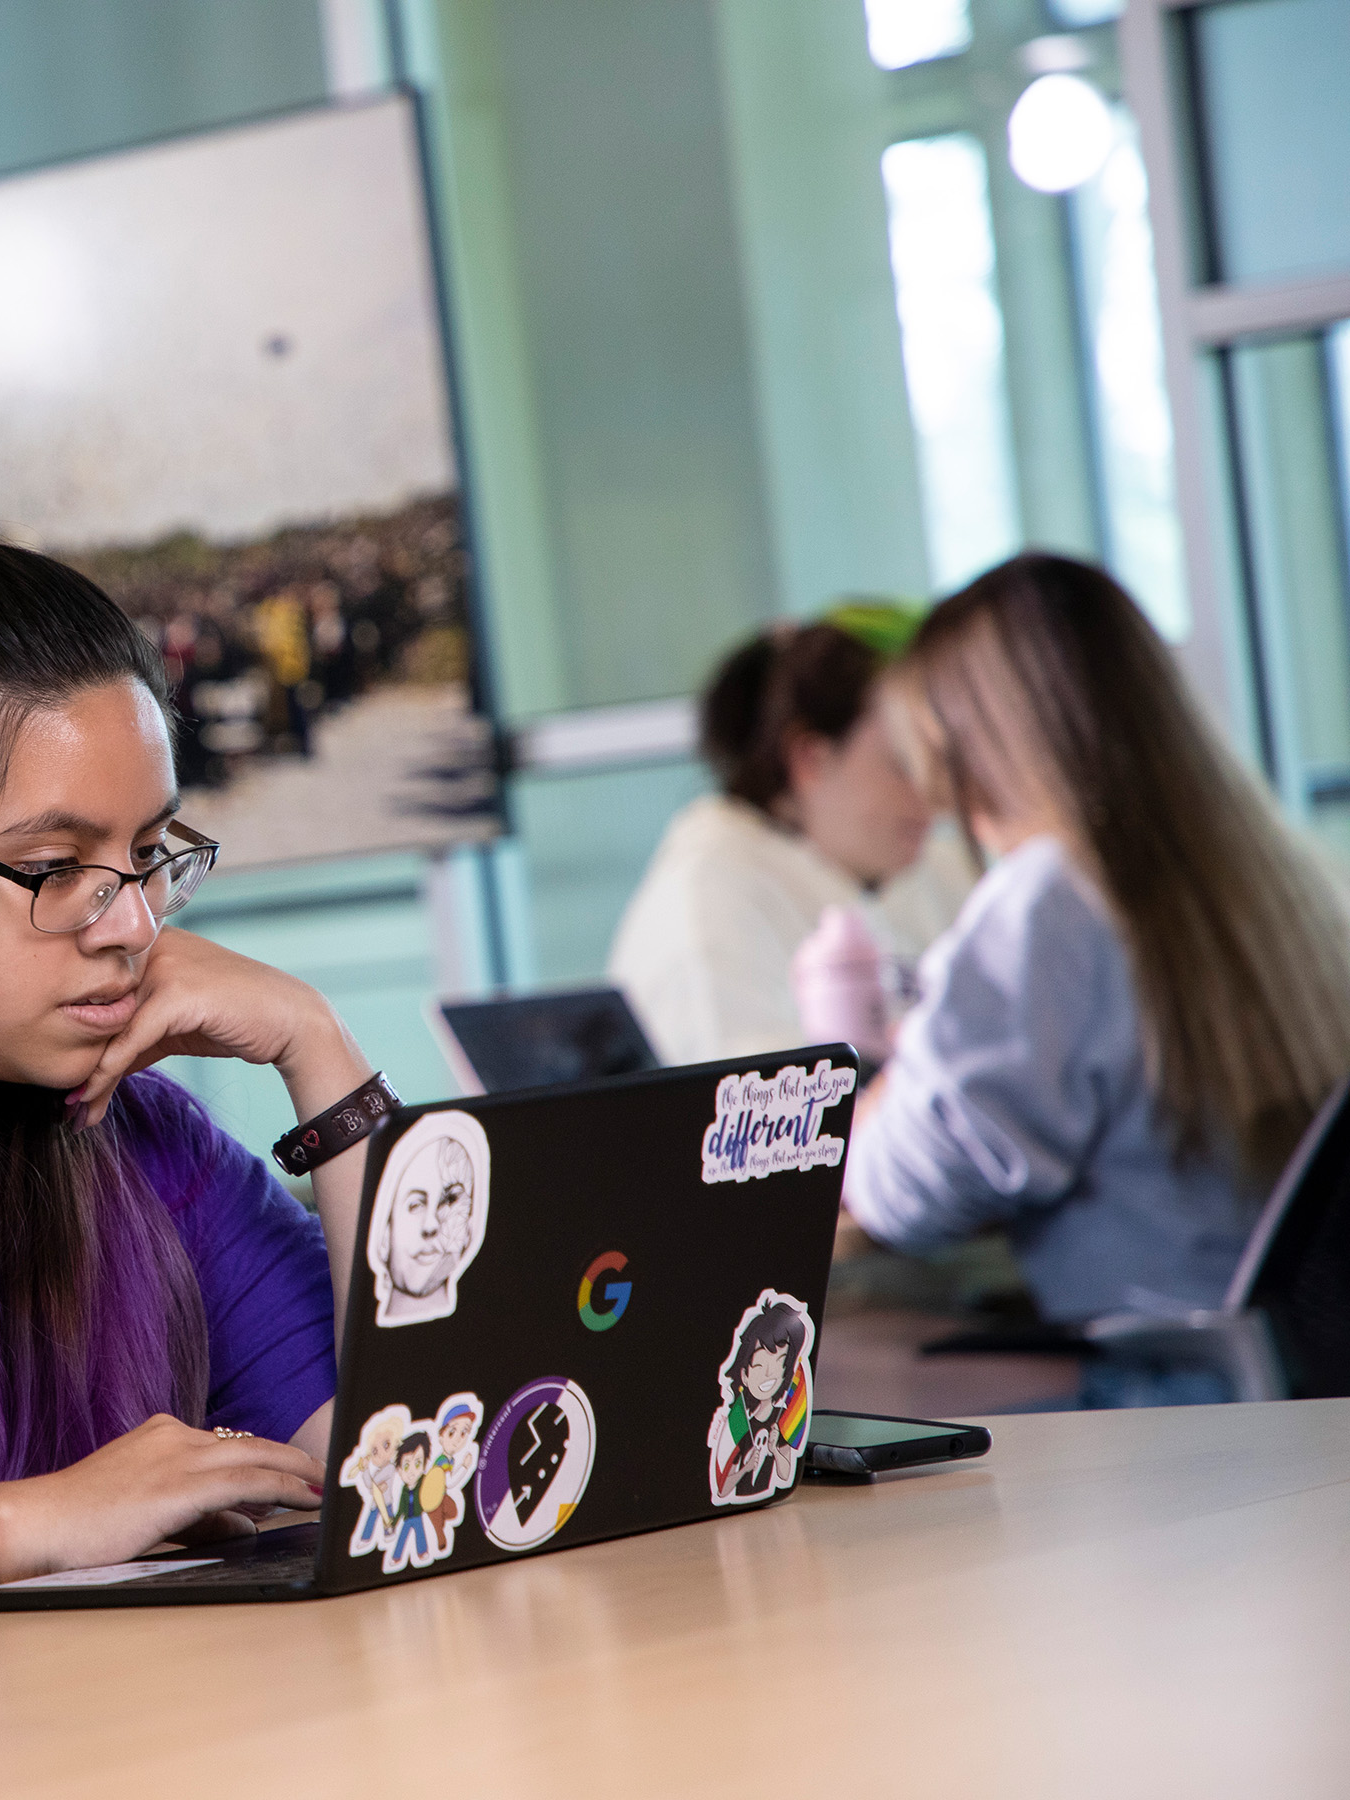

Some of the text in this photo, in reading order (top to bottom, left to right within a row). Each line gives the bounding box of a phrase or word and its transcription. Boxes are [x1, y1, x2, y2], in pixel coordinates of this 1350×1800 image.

[722, 1070, 850, 1111] the things that make you
[708, 1091, 830, 1170] different
[578, 1250, 633, 1332] G
